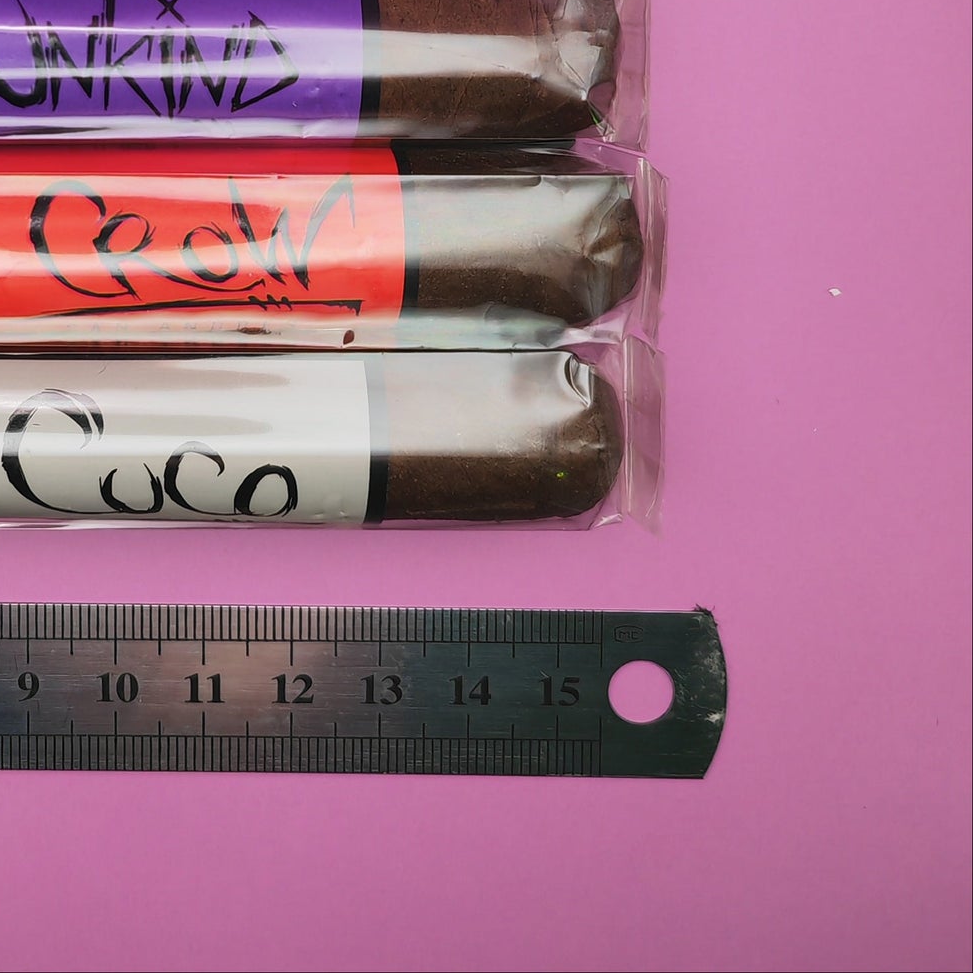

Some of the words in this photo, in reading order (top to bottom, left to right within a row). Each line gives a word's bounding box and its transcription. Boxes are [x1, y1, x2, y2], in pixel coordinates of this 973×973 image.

[17, 672, 40, 702] 9
[96, 672, 139, 703] 10
[184, 673, 225, 704] 11
[271, 673, 314, 704] 12
[360, 674, 403, 705] 13
[449, 675, 492, 706] 14
[539, 676, 580, 707] 15
